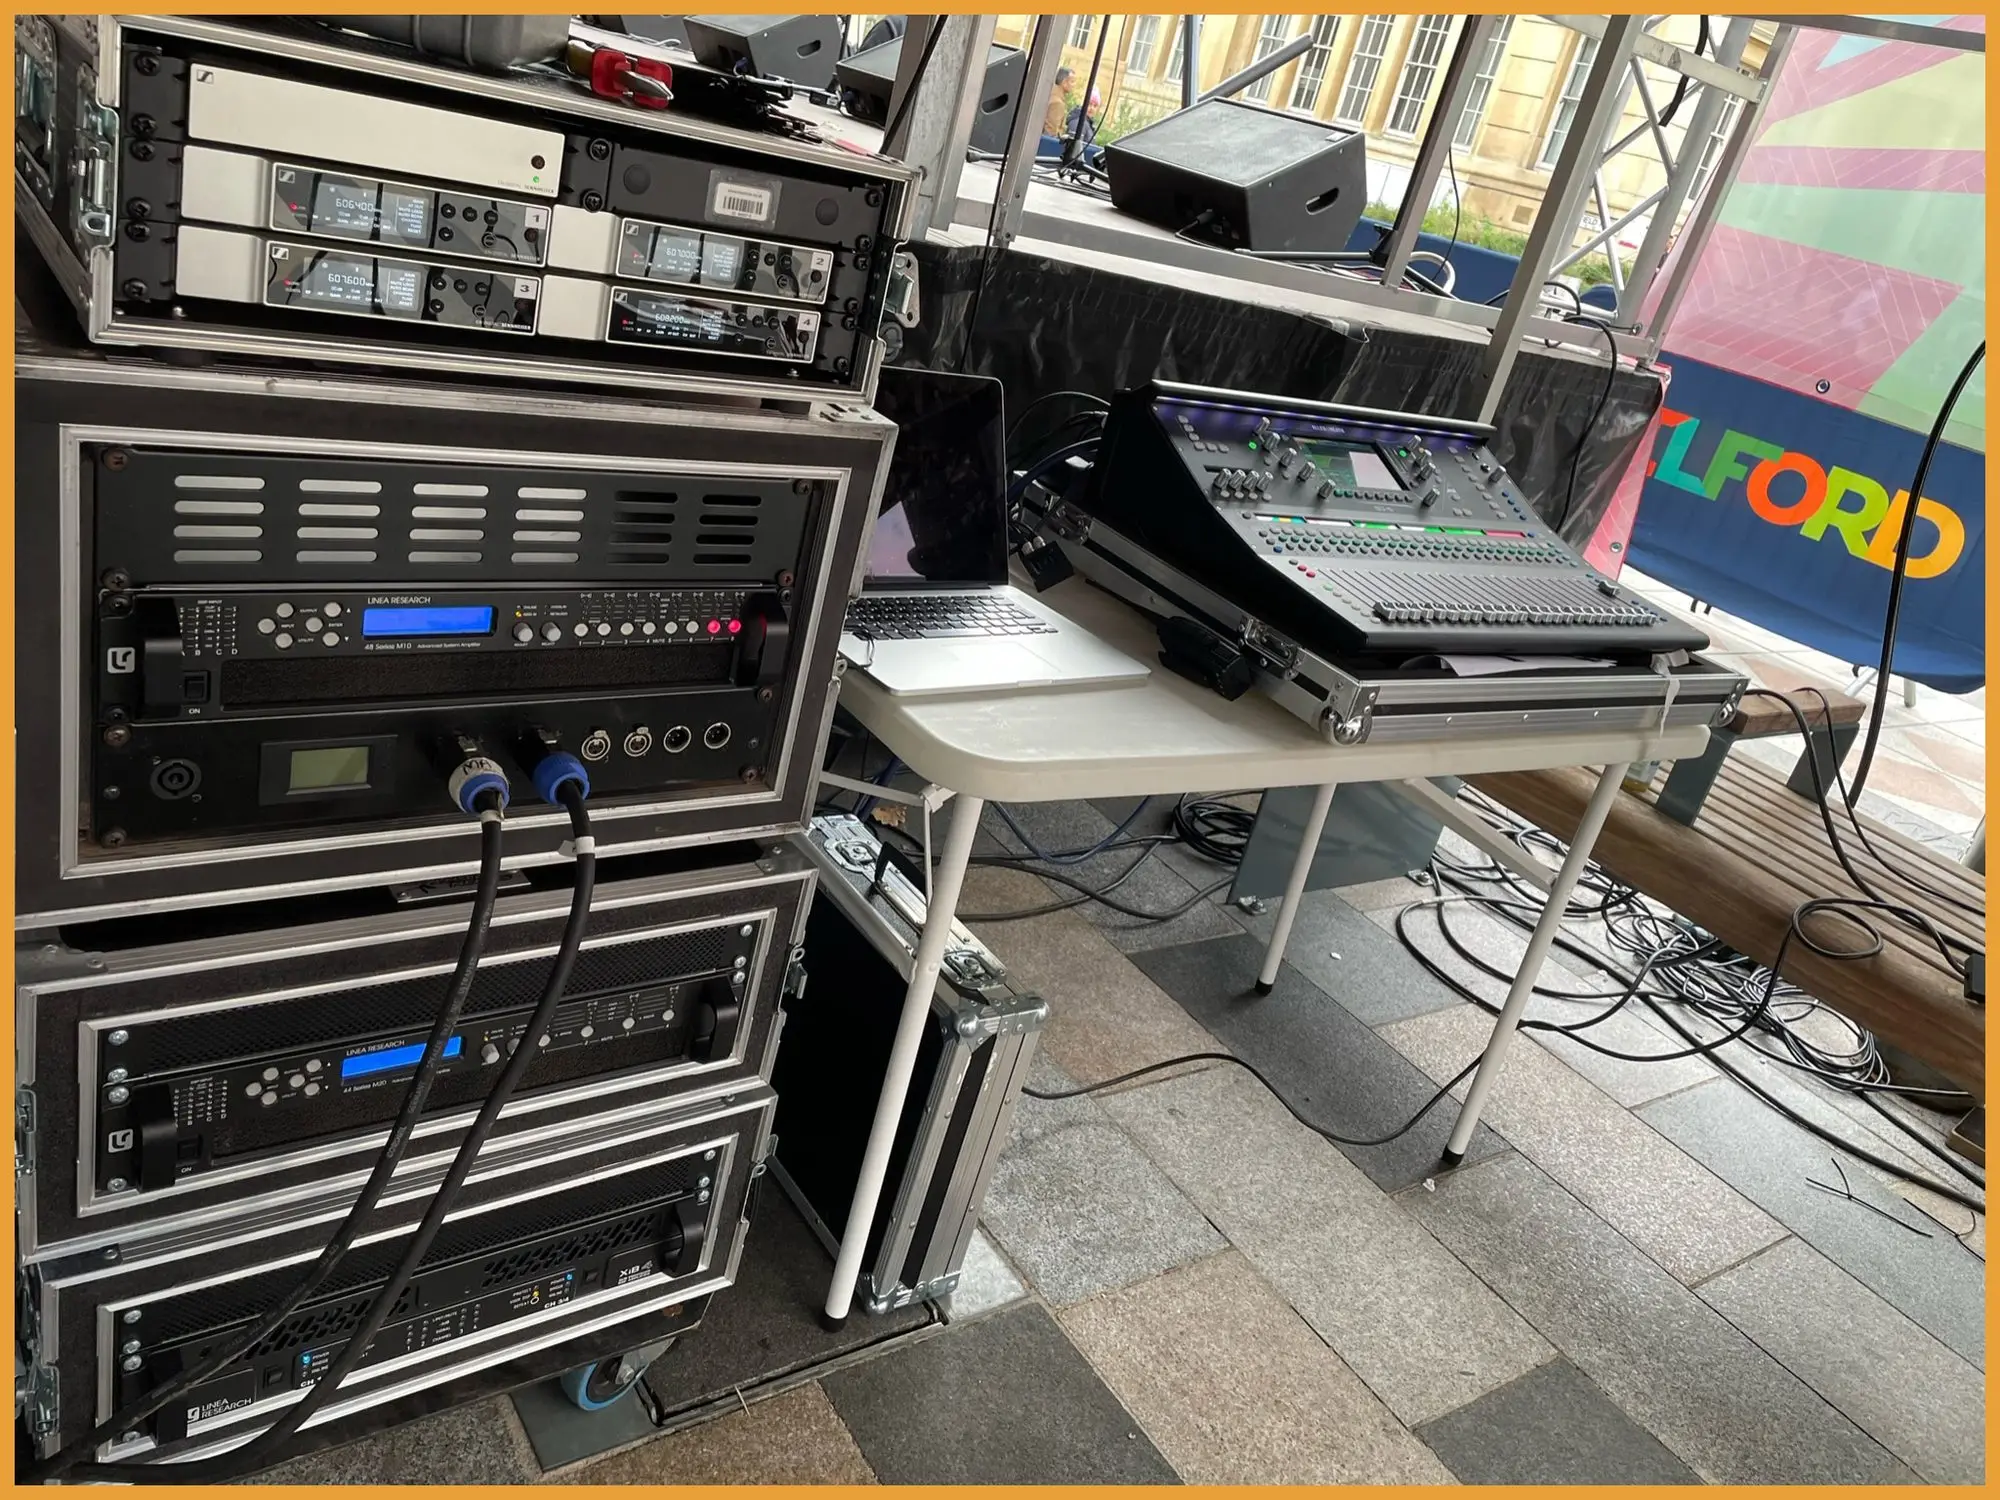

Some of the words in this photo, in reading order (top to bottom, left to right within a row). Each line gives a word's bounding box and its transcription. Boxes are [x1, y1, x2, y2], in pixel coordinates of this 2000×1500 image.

[532, 214, 541, 223] 1
[815, 257, 824, 266] 2
[519, 284, 530, 293] 3
[802, 318, 811, 327] 4
[367, 597, 389, 605] LINEA
[390, 596, 431, 604] RESEARCH
[346, 1048, 367, 1056] LINEA
[367, 1040, 405, 1052] RESEARCH
[300, 1379, 314, 1387] CH
[201, 1398, 229, 1411] LINEA
[201, 1397, 252, 1418] RESEARCH
